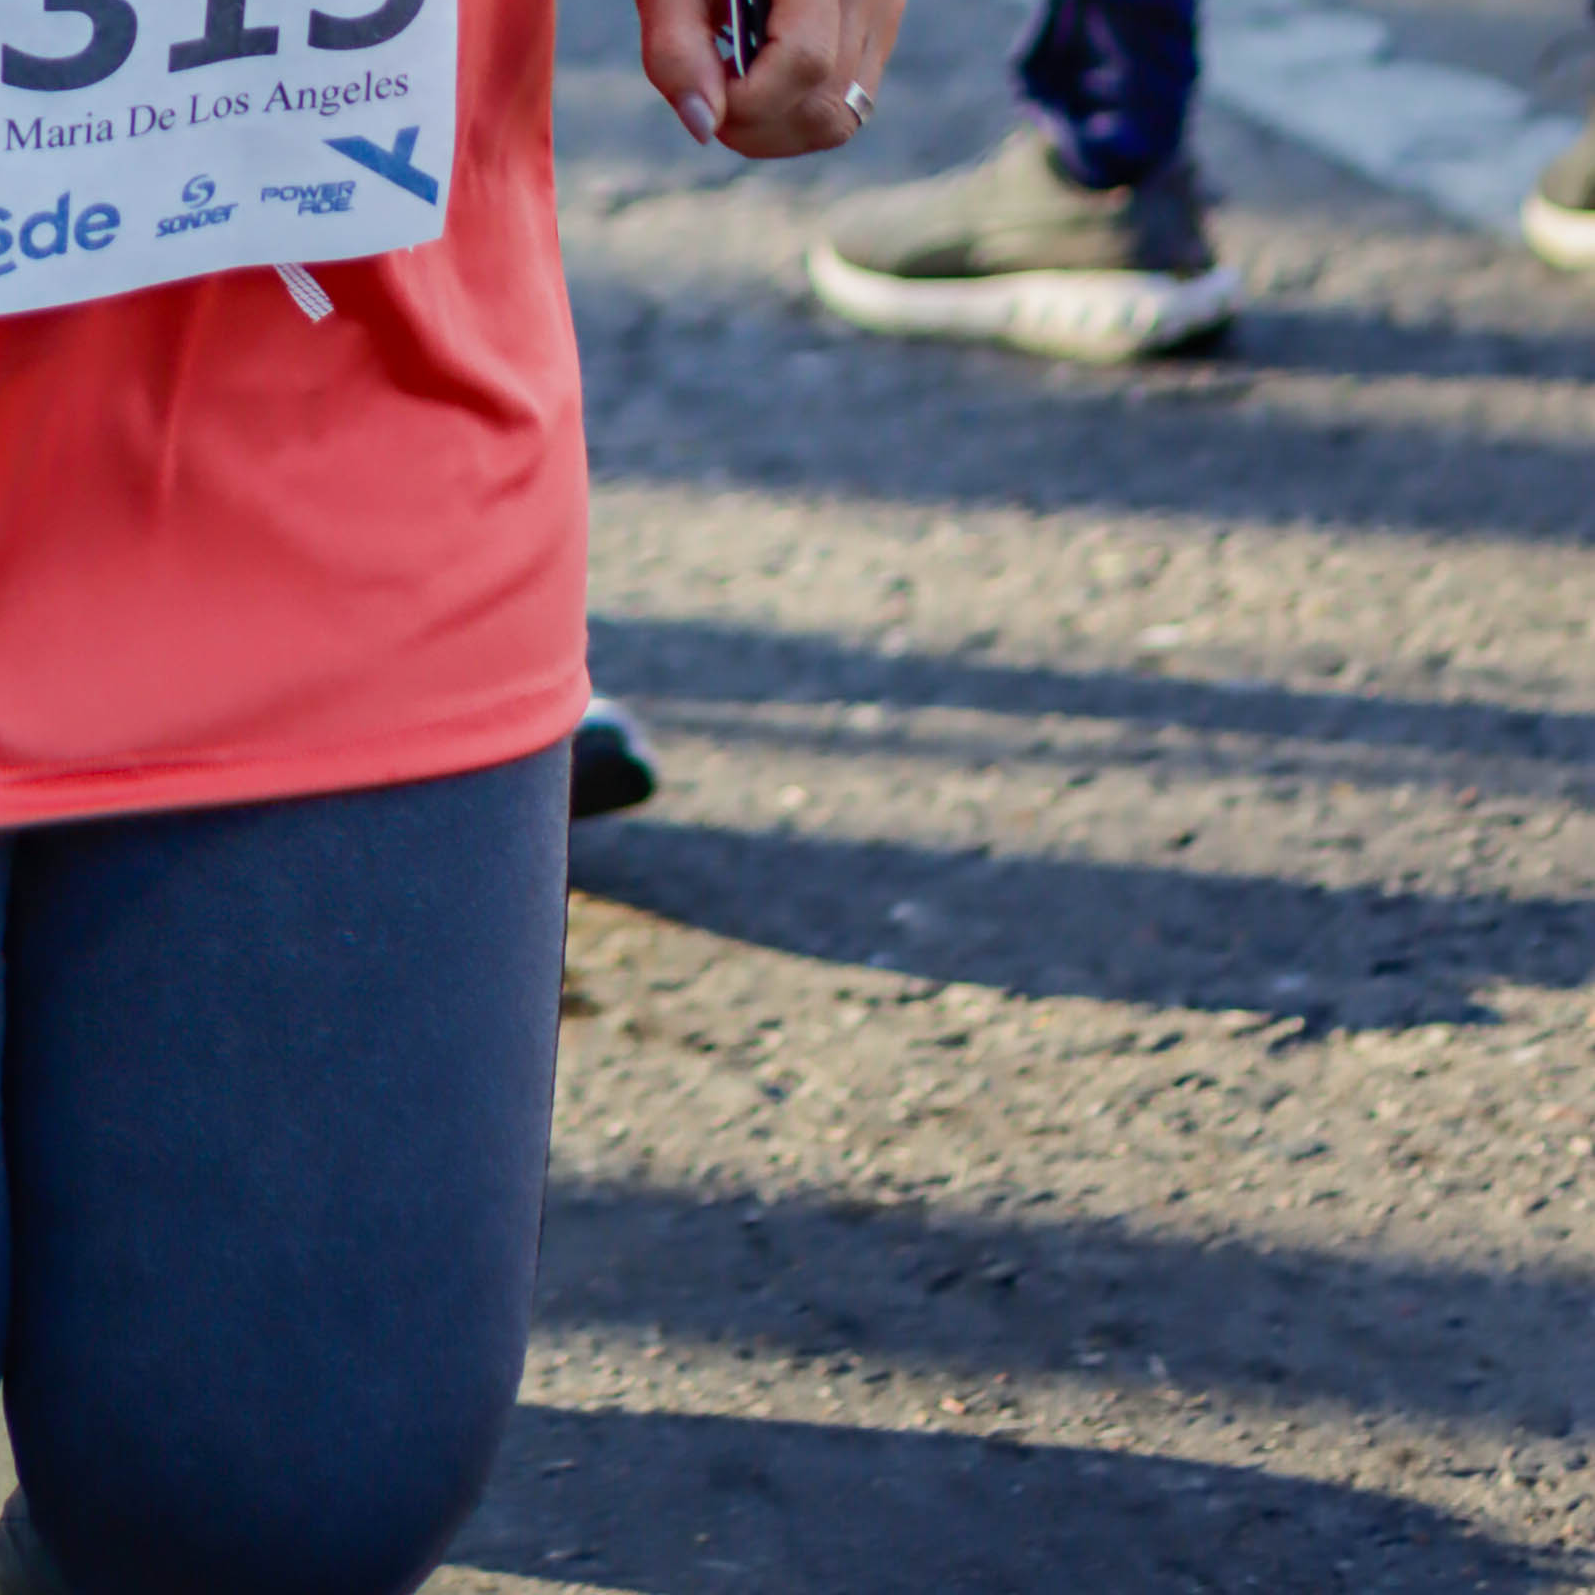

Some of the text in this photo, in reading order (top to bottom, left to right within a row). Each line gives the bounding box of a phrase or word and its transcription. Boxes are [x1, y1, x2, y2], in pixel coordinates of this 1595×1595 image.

[4, 112, 114, 151] Maria
[126, 104, 176, 139] De
[187, 92, 250, 126] Los
[263, 69, 410, 116] Angeles
[261, 180, 356, 203] POWER
